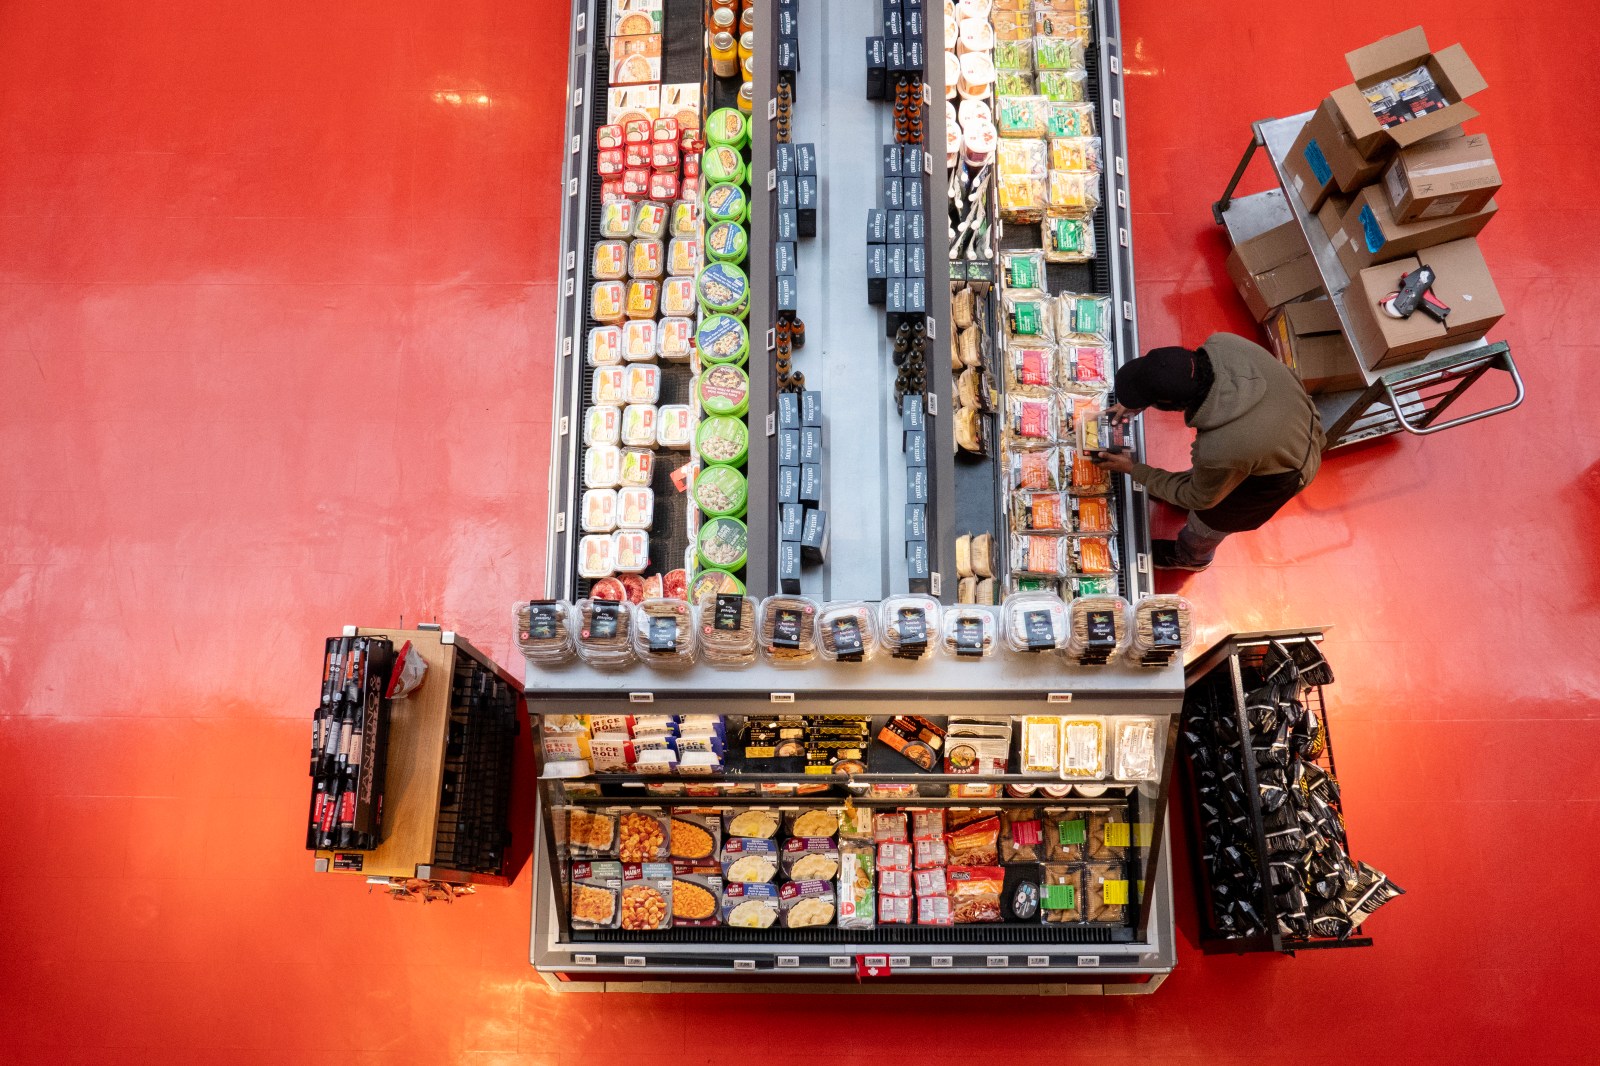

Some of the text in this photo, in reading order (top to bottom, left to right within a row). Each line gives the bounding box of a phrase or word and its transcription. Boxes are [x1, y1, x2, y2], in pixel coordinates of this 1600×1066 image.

[360, 674, 377, 802] FANTINO &
[592, 718, 620, 727] RICE
